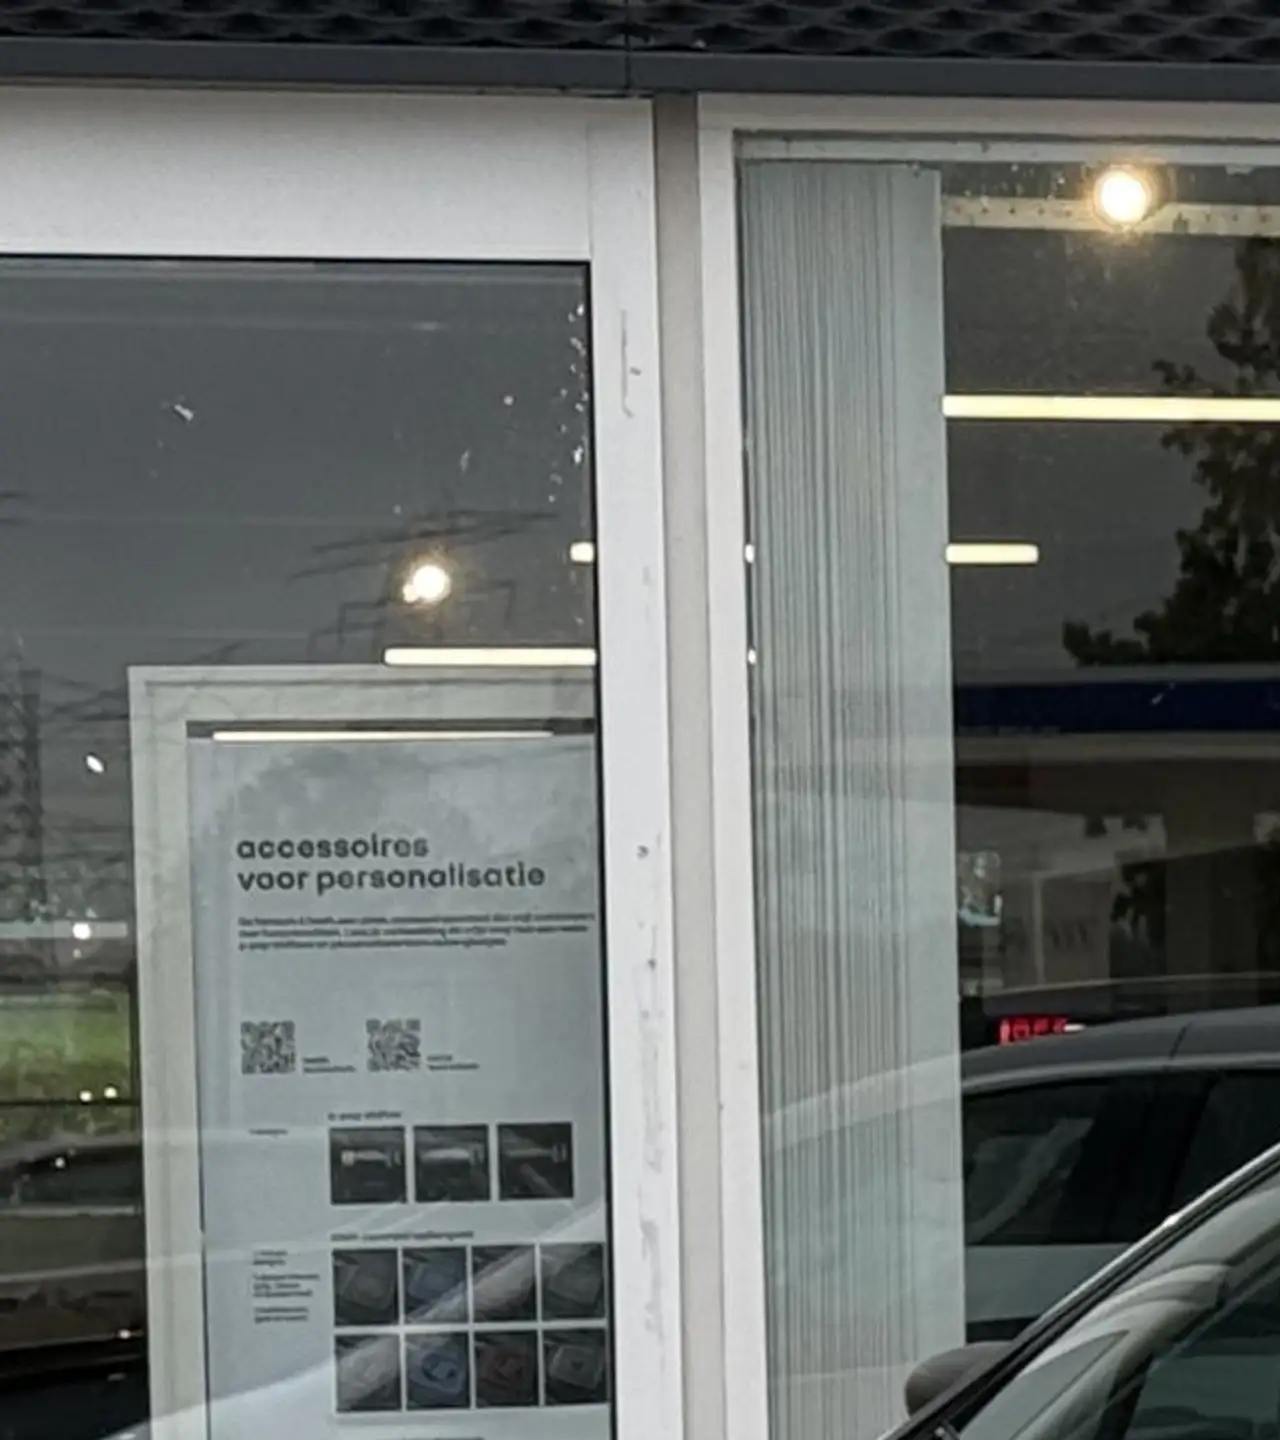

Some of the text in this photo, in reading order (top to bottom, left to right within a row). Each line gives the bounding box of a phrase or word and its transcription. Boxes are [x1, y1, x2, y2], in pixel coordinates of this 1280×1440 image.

[237, 833, 429, 860] accessoires
[237, 861, 546, 897] voor personalisatie
